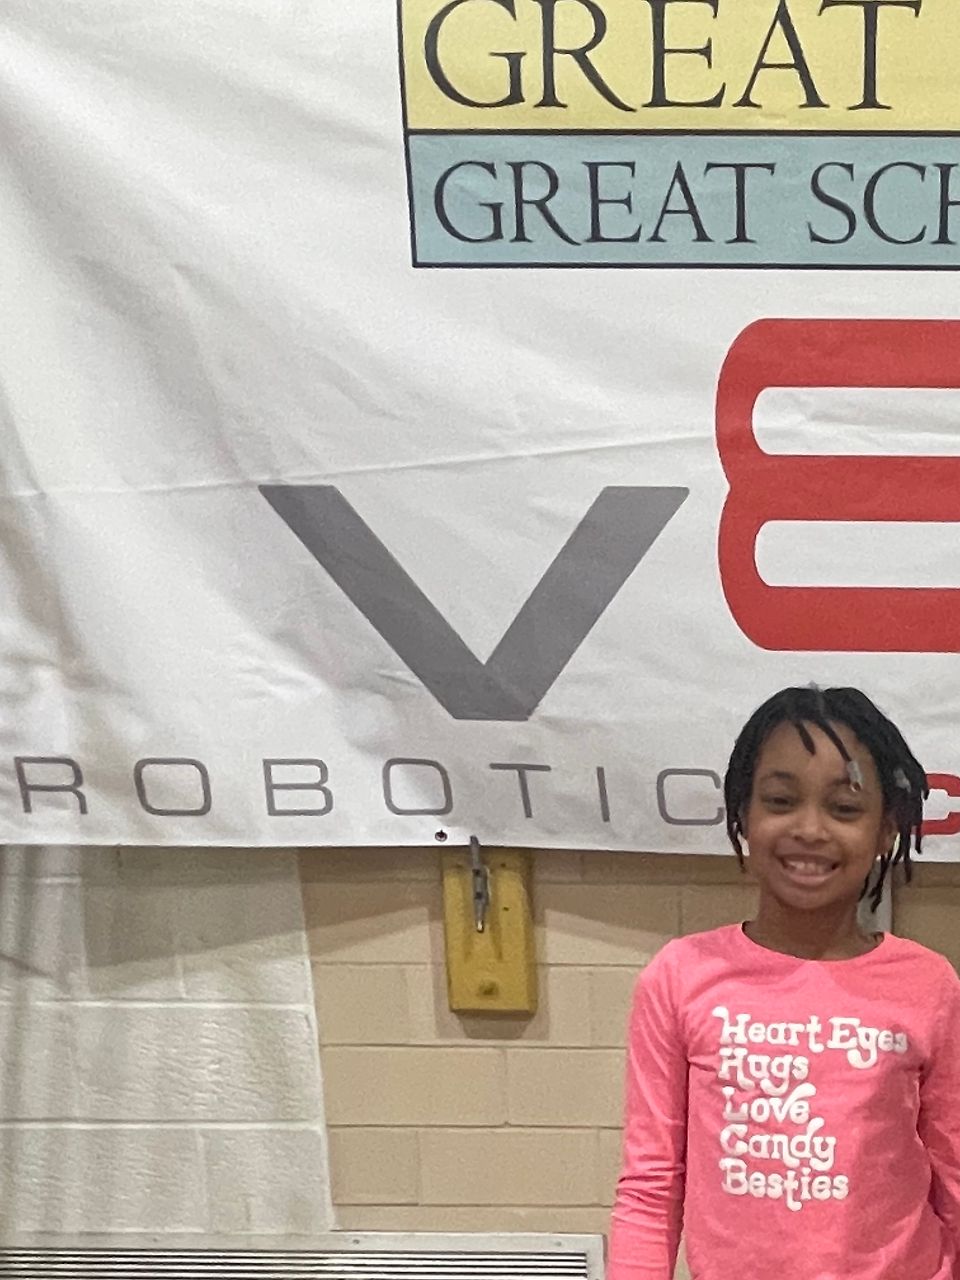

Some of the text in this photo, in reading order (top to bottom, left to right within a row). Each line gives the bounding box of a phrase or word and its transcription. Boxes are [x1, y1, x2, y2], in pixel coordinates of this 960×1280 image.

[424, 0, 922, 112] GREAT
[433, 160, 775, 246] GREAT
[14, 756, 726, 826] ROBOTIC
[712, 1006, 908, 1069] Heart Eyes
[718, 1048, 809, 1095] Hugs
[722, 1082, 816, 1124] Love
[720, 1118, 836, 1171] Candy
[719, 1158, 849, 1212] Besties
